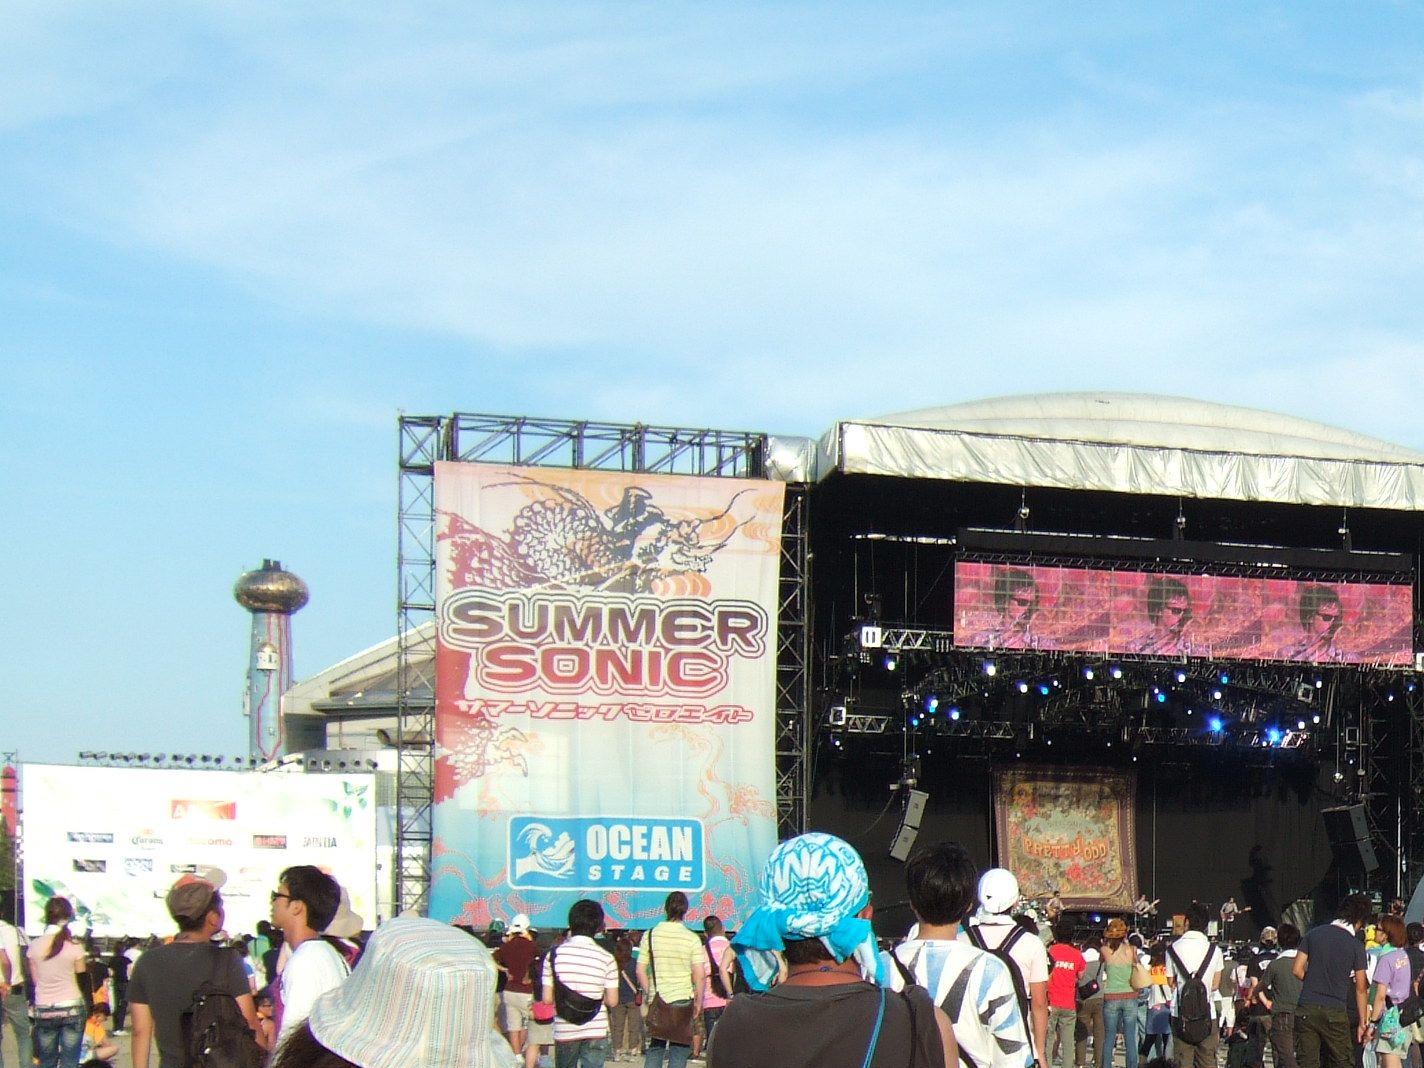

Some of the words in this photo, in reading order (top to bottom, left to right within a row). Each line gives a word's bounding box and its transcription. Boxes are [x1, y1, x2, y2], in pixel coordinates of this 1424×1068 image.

[447, 595, 764, 652] SUMMER
[480, 643, 727, 692] SONIC
[586, 823, 693, 862] OCEAN
[587, 864, 693, 883] STAGE
